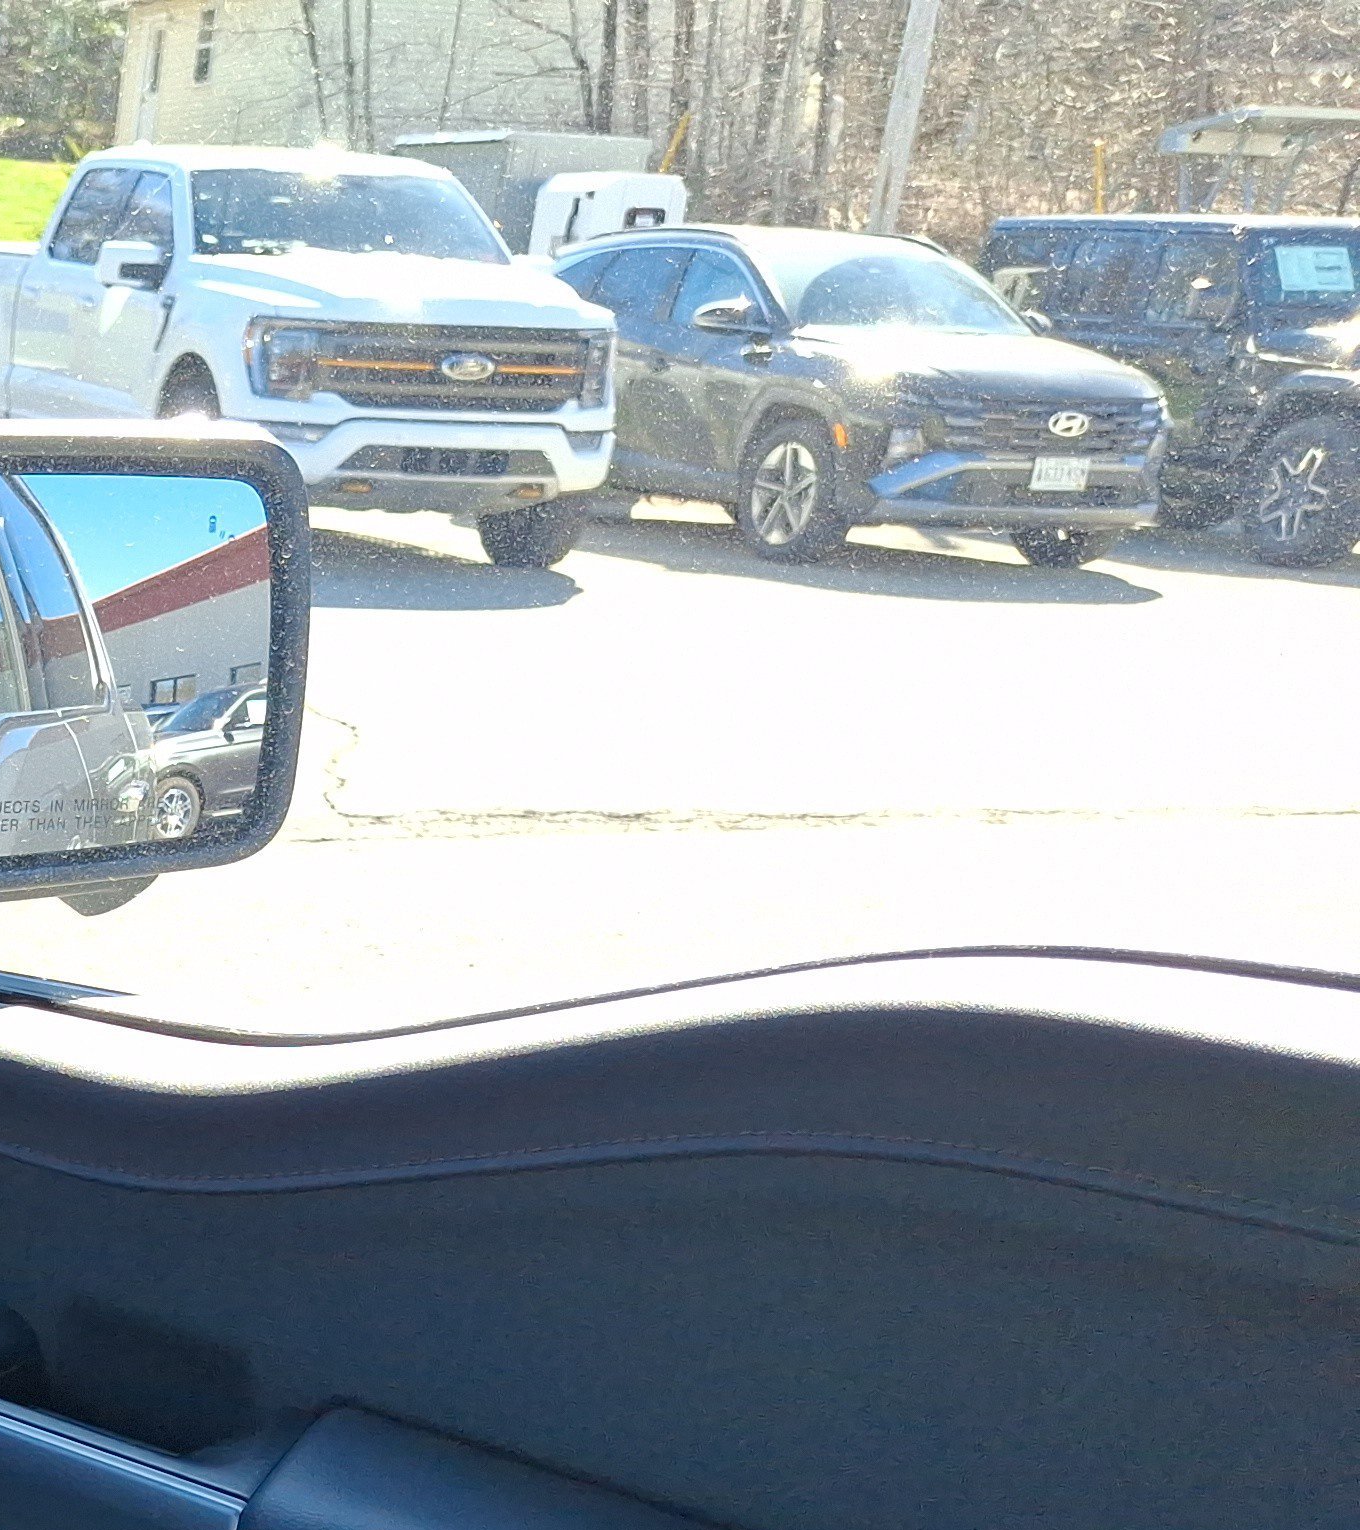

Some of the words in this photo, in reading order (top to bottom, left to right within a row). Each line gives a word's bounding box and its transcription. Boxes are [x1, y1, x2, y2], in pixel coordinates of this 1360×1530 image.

[50, 800, 64, 812] IN
[74, 798, 129, 811] MIRROR
[28, 818, 66, 831] THAN
[75, 815, 112, 829] THEY
